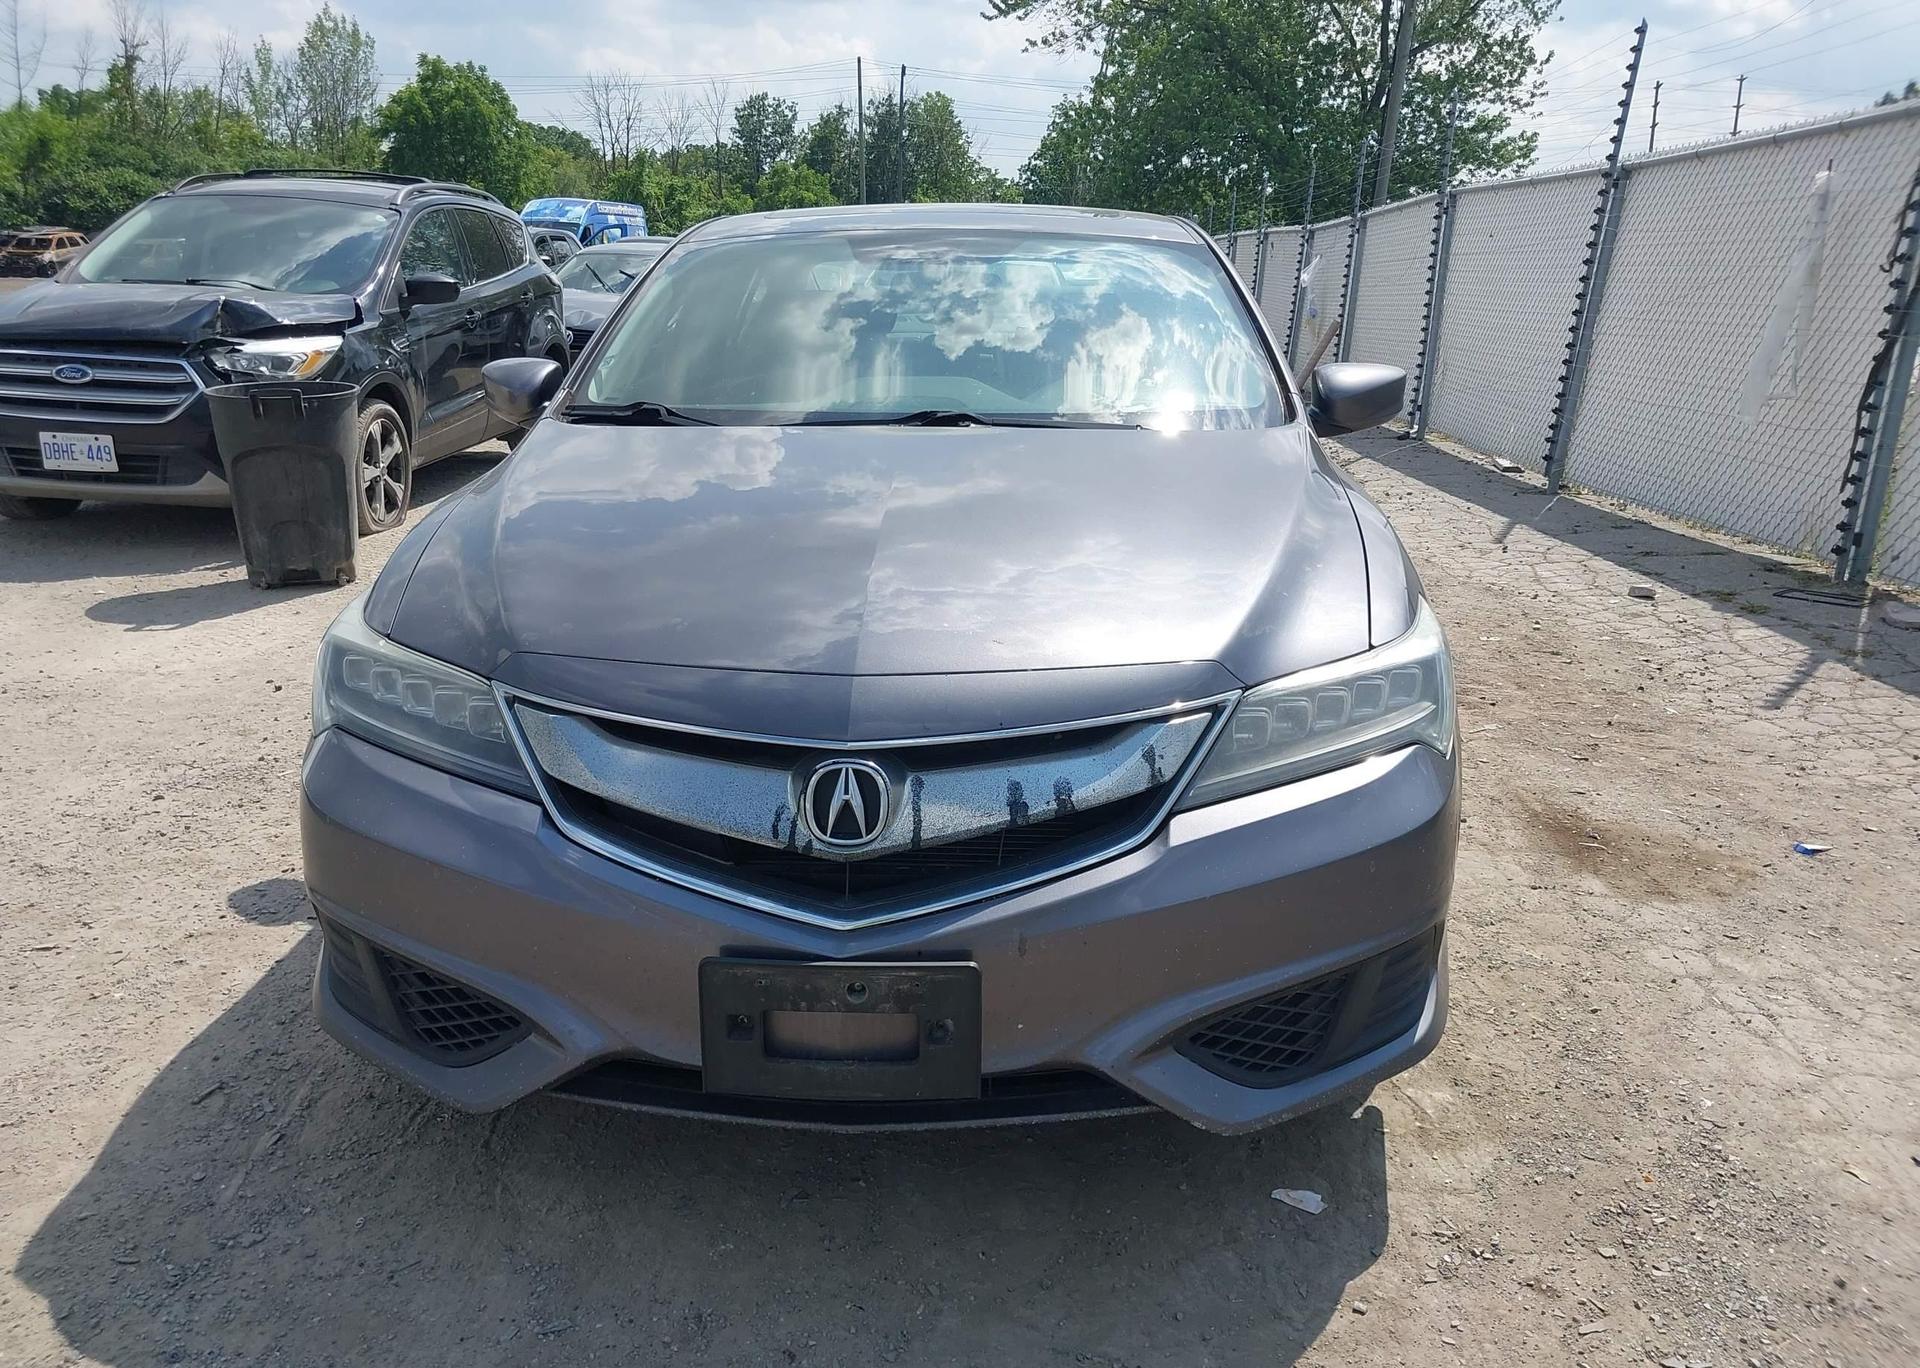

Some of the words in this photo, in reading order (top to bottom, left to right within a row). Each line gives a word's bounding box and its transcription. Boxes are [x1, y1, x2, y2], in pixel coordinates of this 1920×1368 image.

[60, 367, 82, 378] Ford
[43, 442, 79, 461] DBHE
[87, 444, 113, 462] 449
